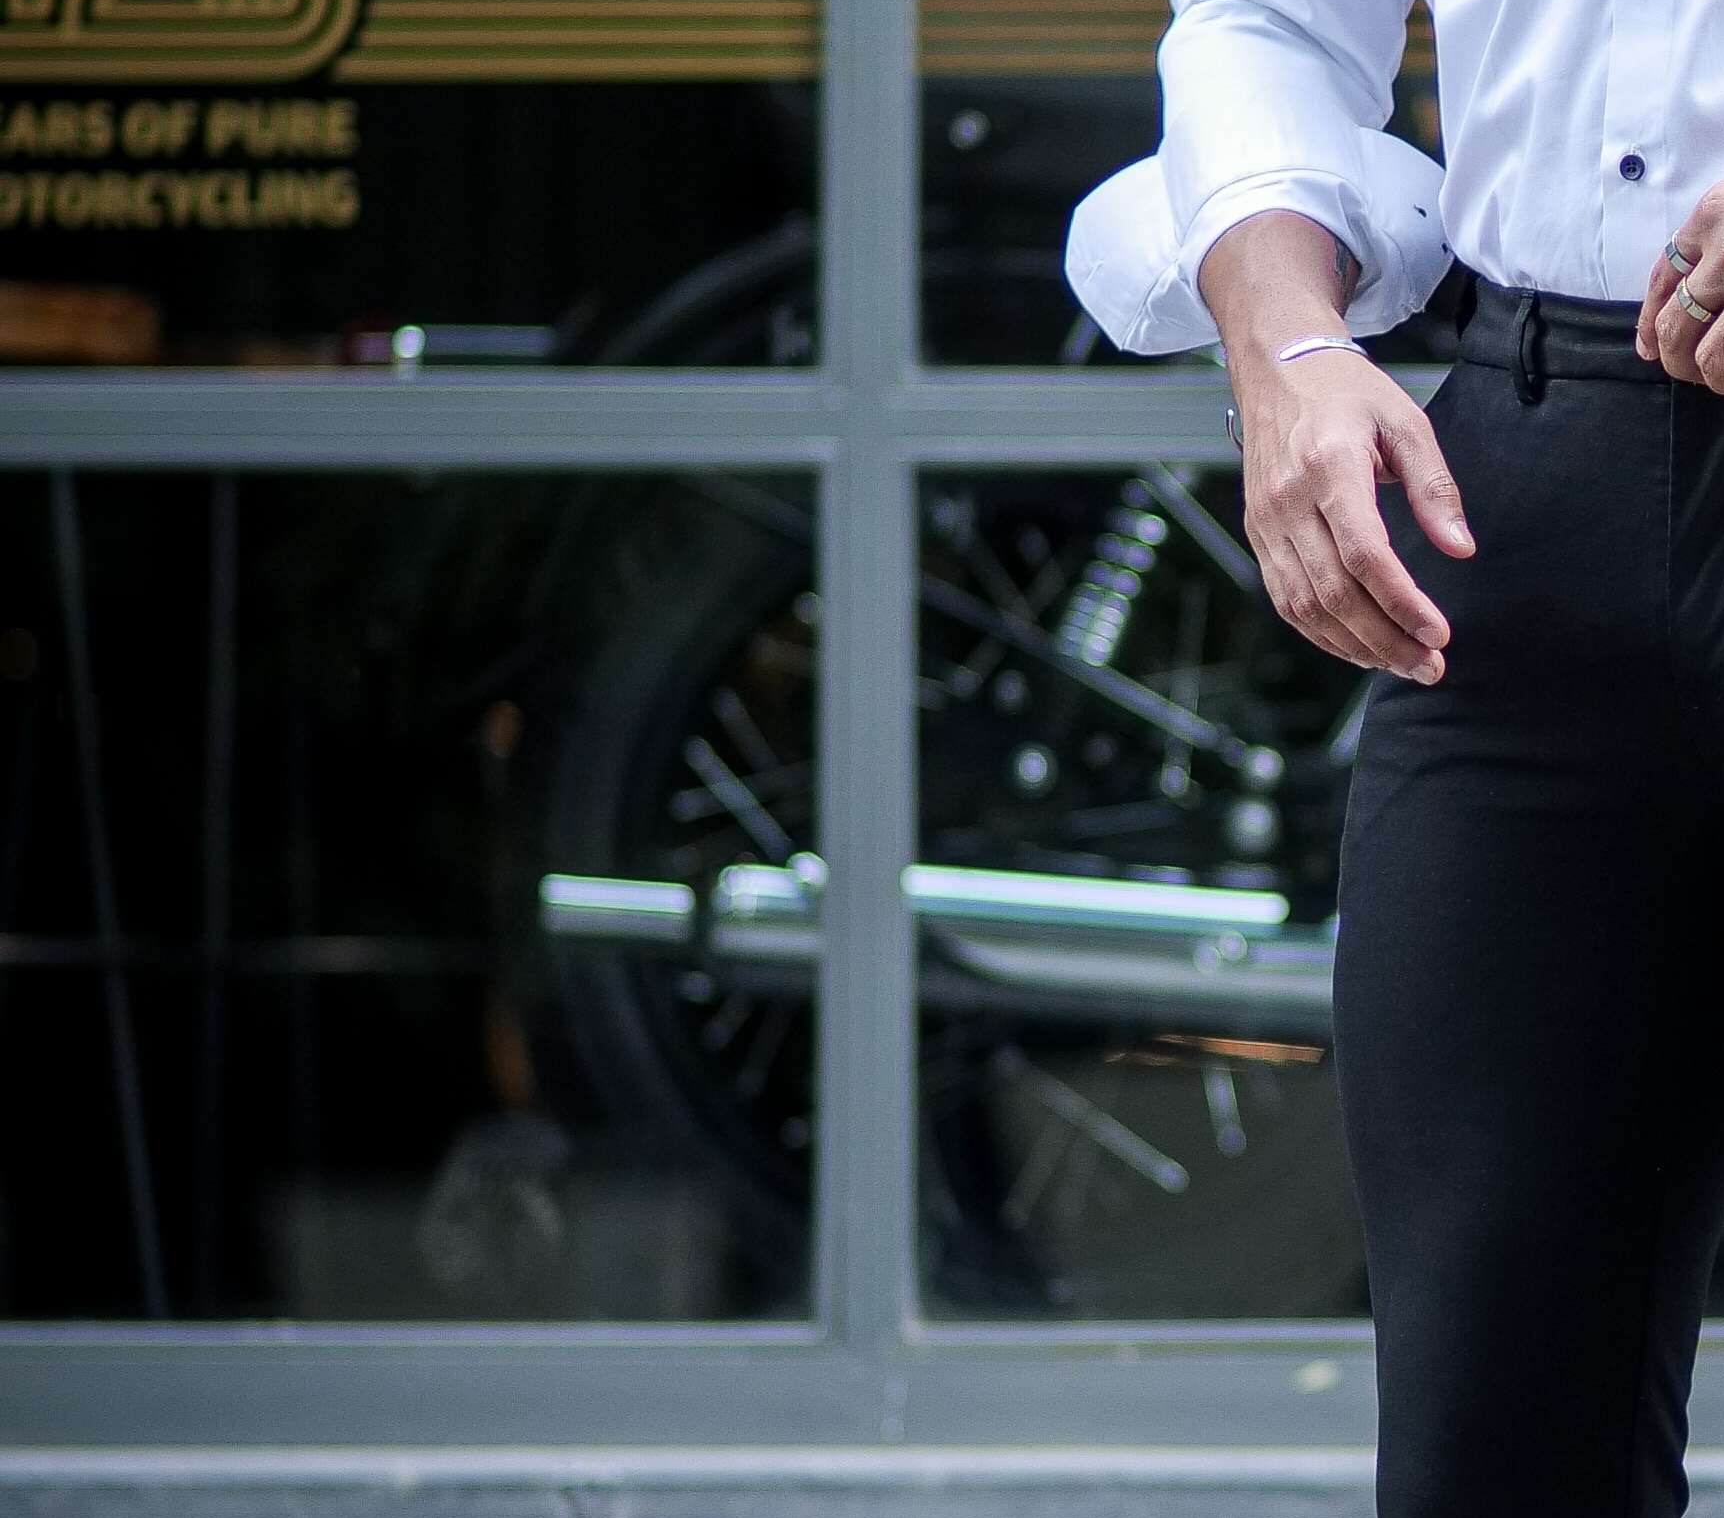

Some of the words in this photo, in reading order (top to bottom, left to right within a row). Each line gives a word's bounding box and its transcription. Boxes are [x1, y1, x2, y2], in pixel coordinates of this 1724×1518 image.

[0, 99, 113, 158] ARS
[122, 99, 199, 158] OF
[205, 99, 360, 158] PURE
